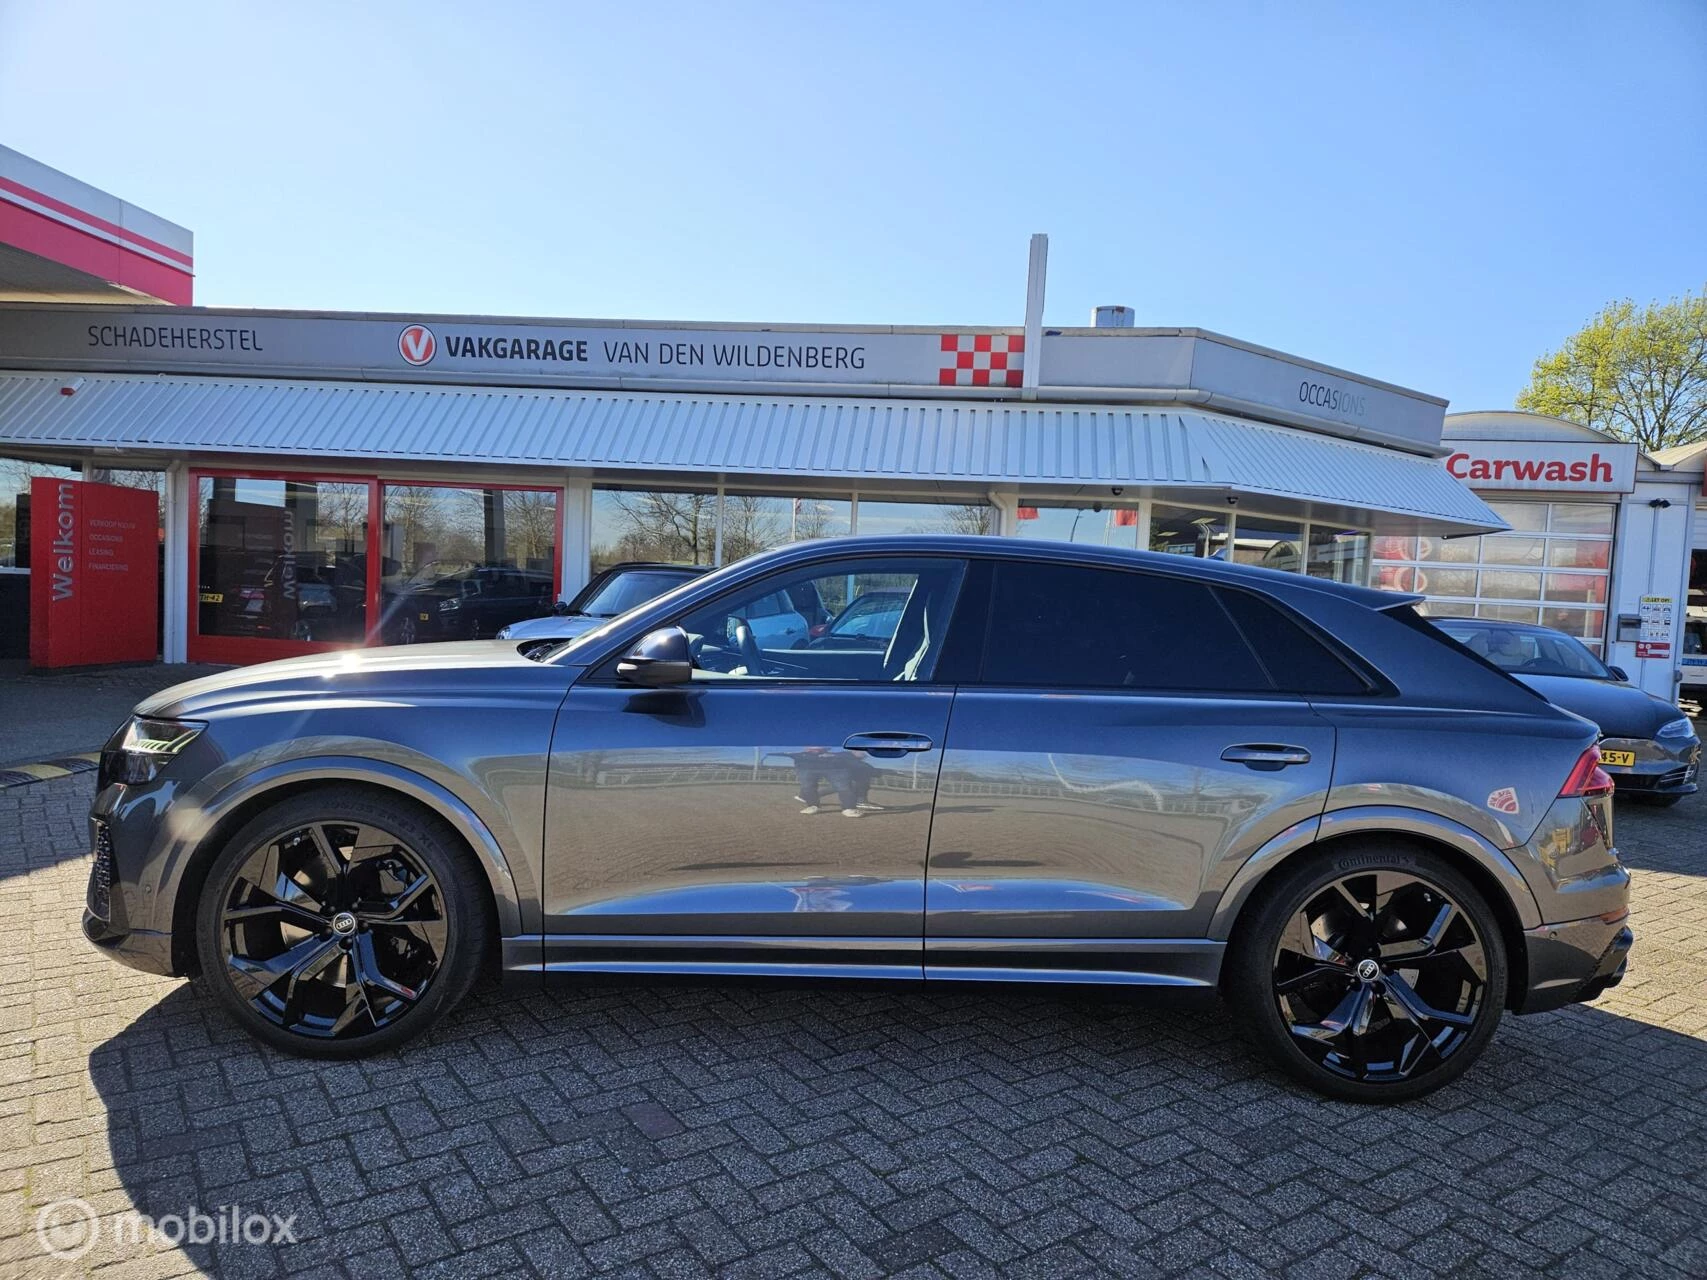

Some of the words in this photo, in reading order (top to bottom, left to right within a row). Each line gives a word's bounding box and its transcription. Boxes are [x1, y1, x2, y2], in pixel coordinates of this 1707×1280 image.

[88, 325, 263, 351] SCHADEHERSTEL
[445, 336, 588, 362] VAKGARAGE
[604, 341, 649, 364] VAN
[659, 343, 704, 365] DEN
[713, 344, 866, 369] WILDENBERG
[1299, 381, 1366, 417] OCCASIONS
[1446, 453, 1613, 483] Carwash
[53, 483, 75, 601] Welkom
[1338, 855, 1402, 870] Continental
